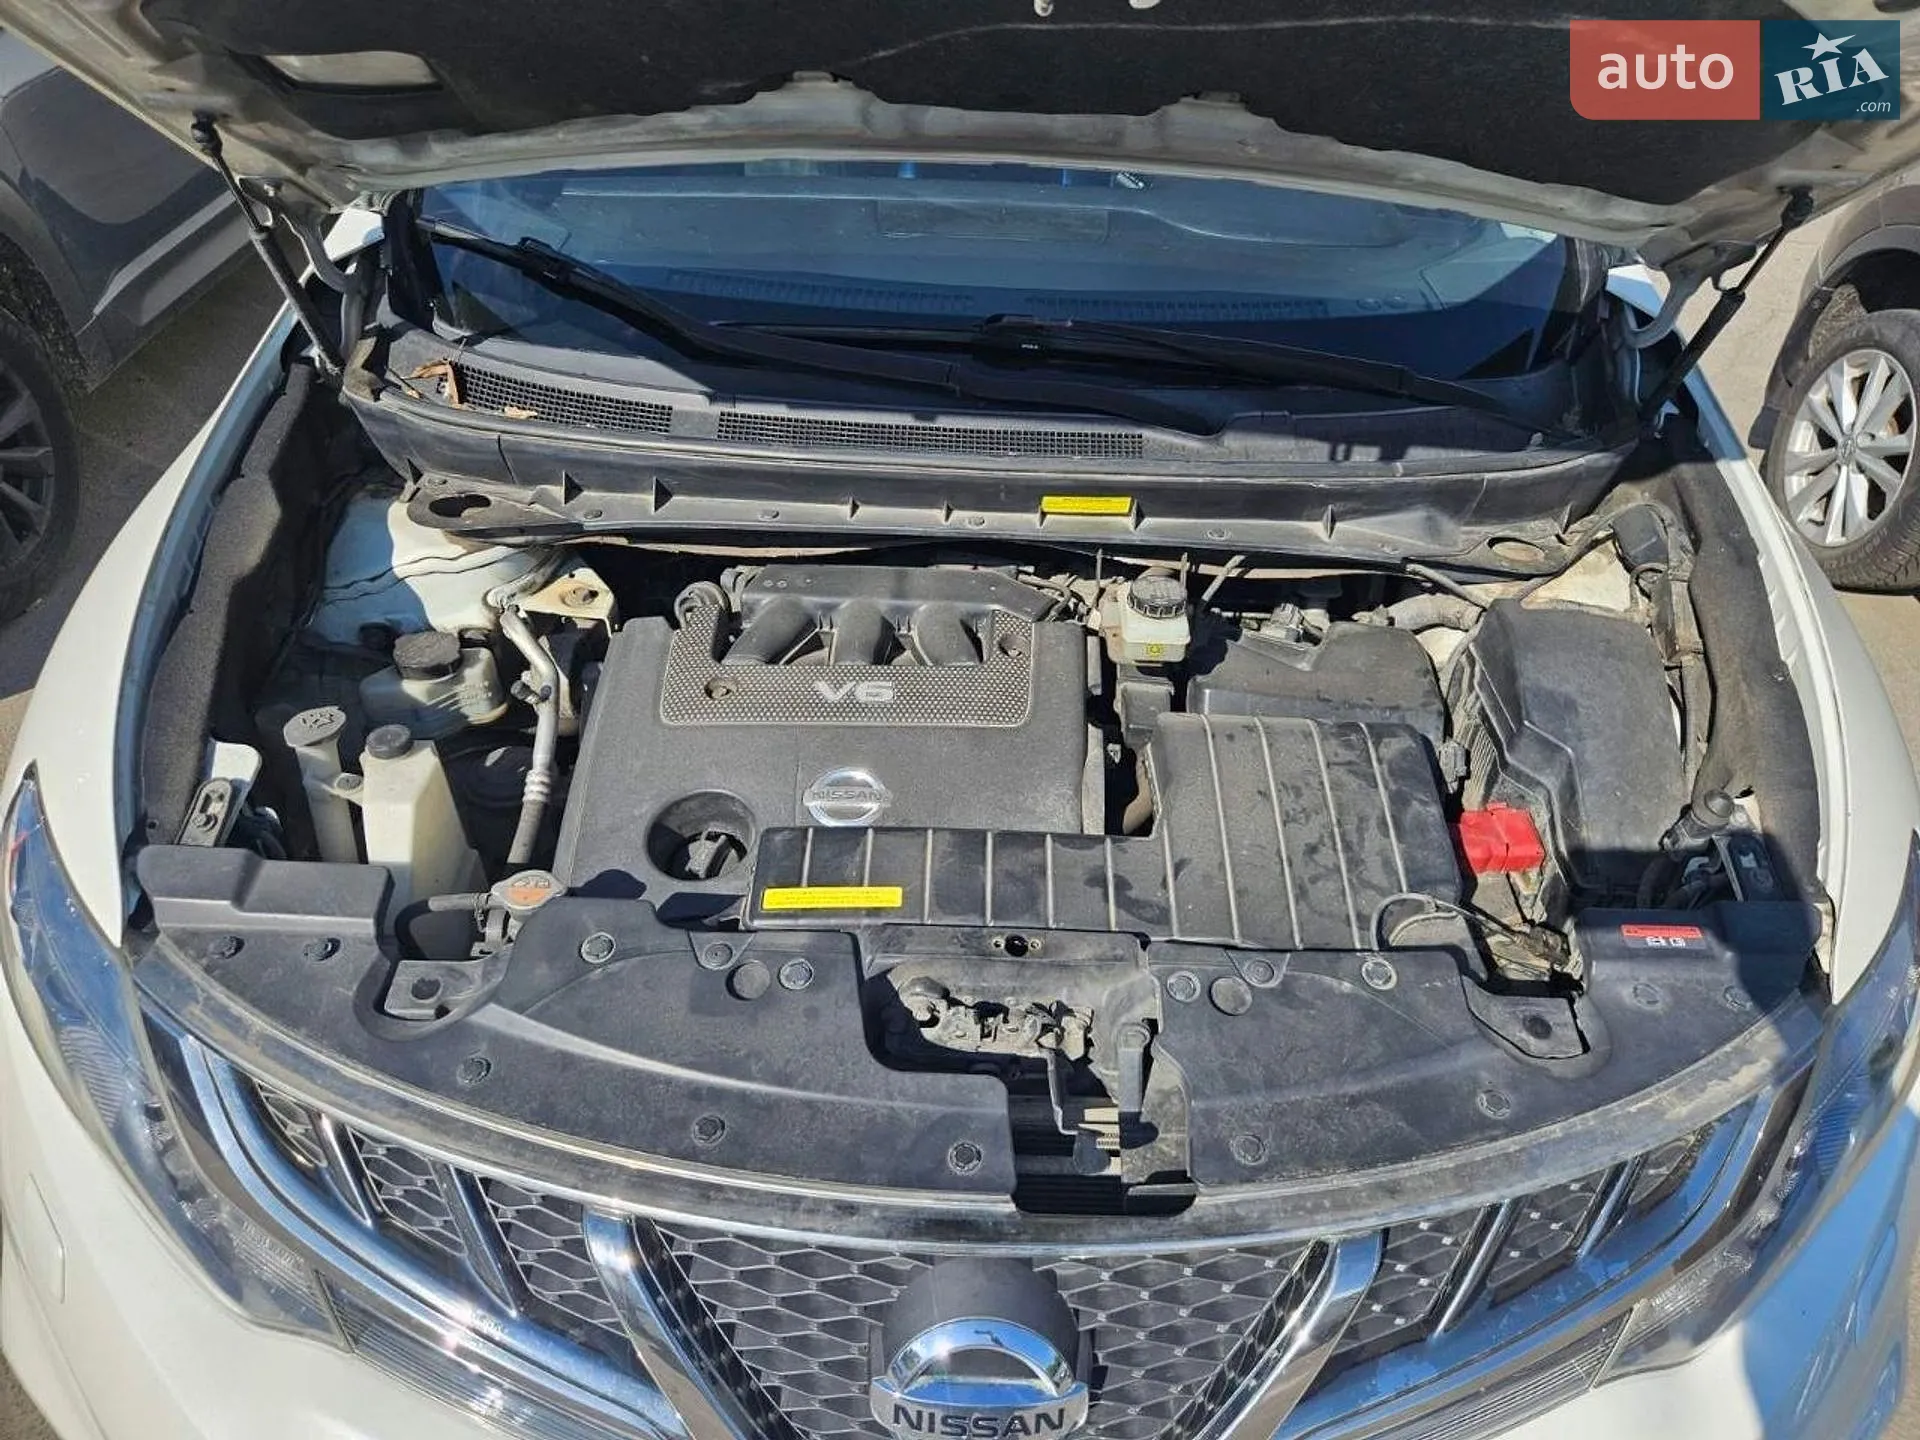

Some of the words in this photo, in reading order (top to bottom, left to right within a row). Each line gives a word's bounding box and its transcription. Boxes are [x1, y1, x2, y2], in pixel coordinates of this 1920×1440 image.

[813, 679, 895, 702] V6
[811, 788, 881, 802] NISSAN
[892, 1402, 1066, 1438] NISSAN
